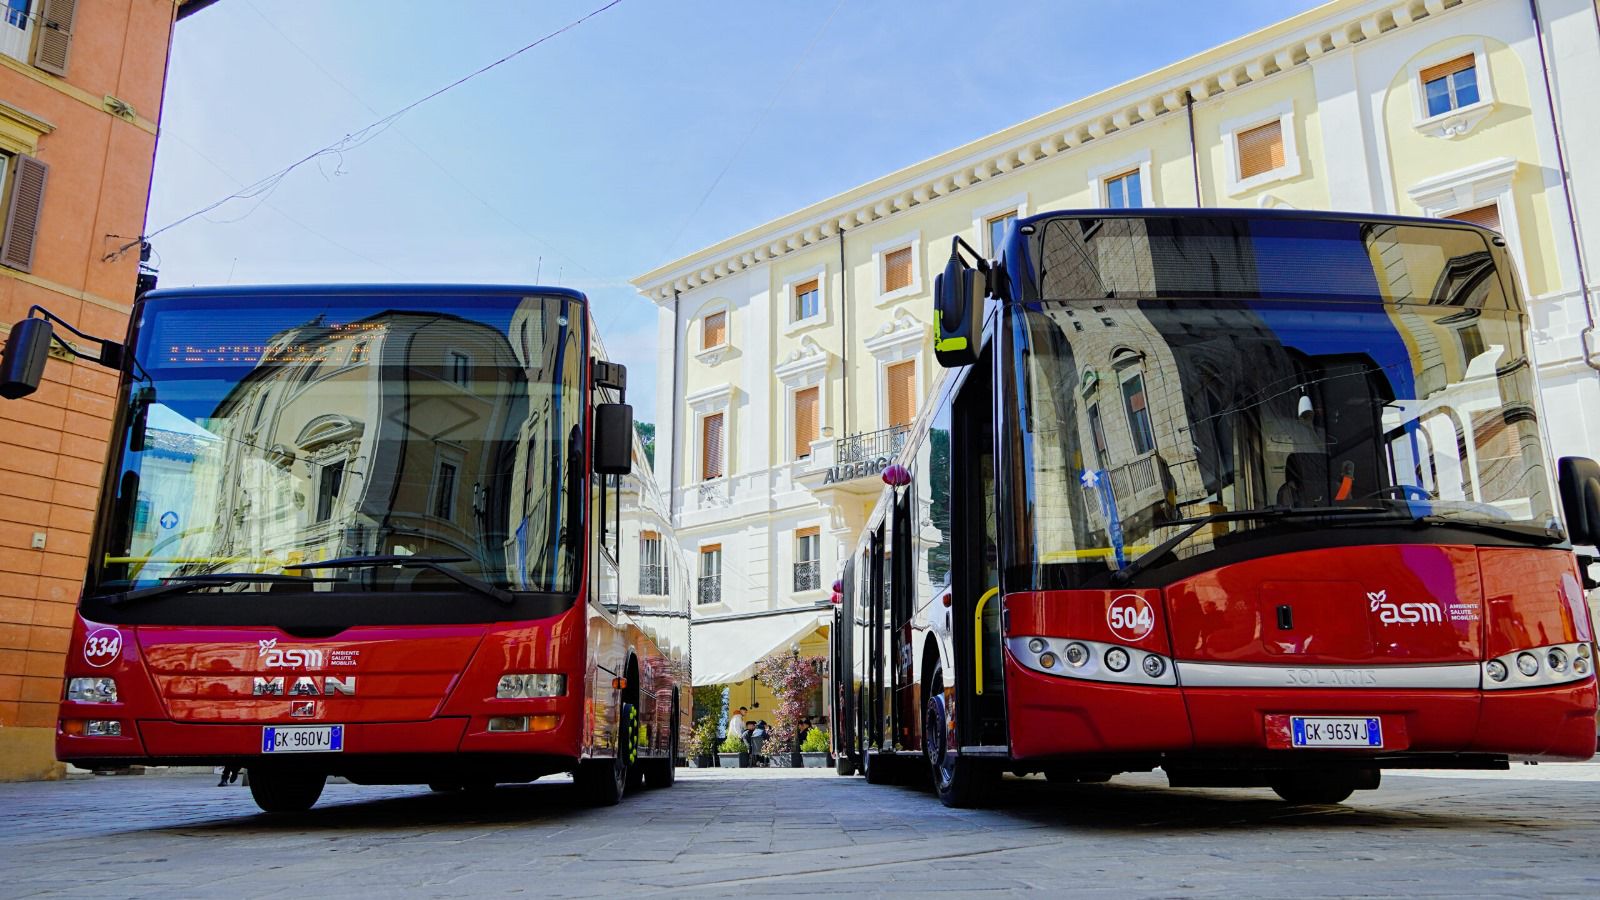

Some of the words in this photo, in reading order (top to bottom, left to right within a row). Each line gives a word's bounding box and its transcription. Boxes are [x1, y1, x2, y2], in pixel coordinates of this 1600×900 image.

[1111, 606, 1150, 629] 504
[1380, 603, 1442, 623] asm
[86, 636, 119, 657] 334
[265, 649, 323, 667] asm
[252, 676, 356, 696] MAN
[1286, 669, 1377, 685] SOLARIS
